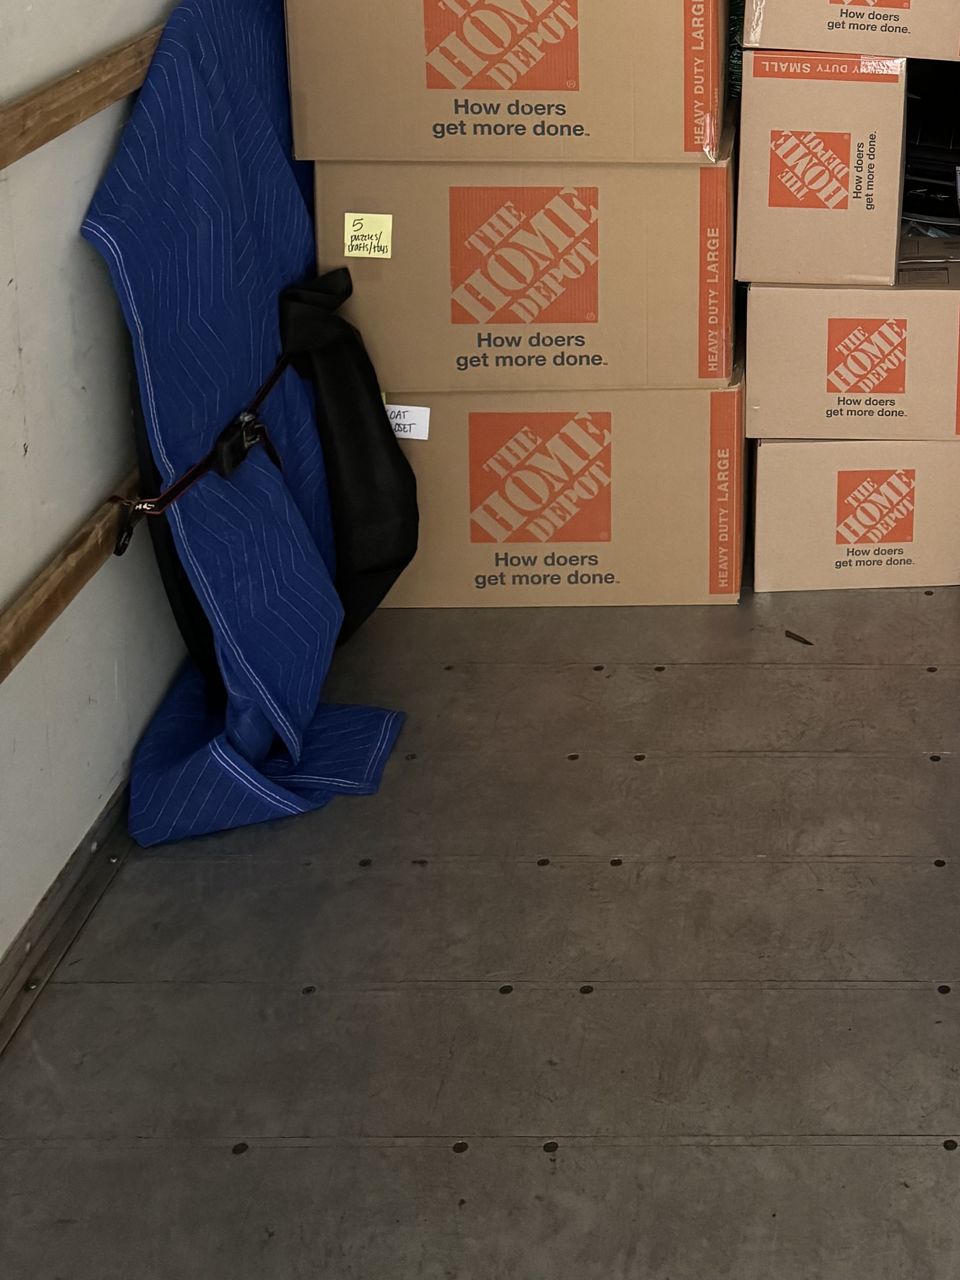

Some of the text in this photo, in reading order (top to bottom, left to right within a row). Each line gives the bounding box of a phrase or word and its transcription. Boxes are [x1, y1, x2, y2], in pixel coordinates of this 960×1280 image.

[827, 21, 846, 30] get
[848, 22, 877, 32] more
[840, 8, 900, 22] How doers
[486, 0, 578, 90] DEPOT
[693, 57, 705, 94] DUTY
[761, 61, 811, 73] SMALL
[816, 64, 848, 73] DUTY
[454, 99, 567, 116] How doers
[694, 100, 704, 145] HEAVY
[432, 120, 467, 139] get
[473, 123, 527, 136] more
[770, 130, 849, 209] HOME
[800, 132, 849, 178] DEPOT
[778, 168, 809, 201] THE
[853, 142, 864, 199] How doers
[867, 163, 875, 191] more
[866, 193, 875, 210] get
[352, 218, 364, 232] 5
[464, 201, 527, 256] THE
[451, 186, 599, 324] HOME
[508, 238, 599, 324] DEPOT
[707, 228, 719, 372] HEAVY DUTY LARGE
[477, 332, 585, 348] How doers
[835, 326, 869, 357] THE
[456, 352, 489, 370] get
[496, 354, 547, 367] more
[827, 318, 907, 393] HOME
[857, 346, 906, 393] DEPOT
[385, 409, 408, 420] OAT
[826, 408, 843, 418] get
[846, 408, 874, 417] more
[837, 397, 895, 406] How doers
[394, 423, 416, 433] OSET
[482, 426, 543, 479] THE
[471, 412, 611, 543] HOME
[525, 460, 611, 543] DEPOT
[836, 469, 915, 544] HOME
[844, 478, 878, 508] THE
[716, 448, 730, 588] HEAVY DUTY LARGE
[865, 497, 914, 544] DEPOT
[494, 551, 598, 567] How doers
[835, 558, 852, 568] get
[855, 558, 883, 566] more
[847, 547, 903, 556] How doers
[474, 571, 506, 589] get
[511, 572, 561, 585] more
